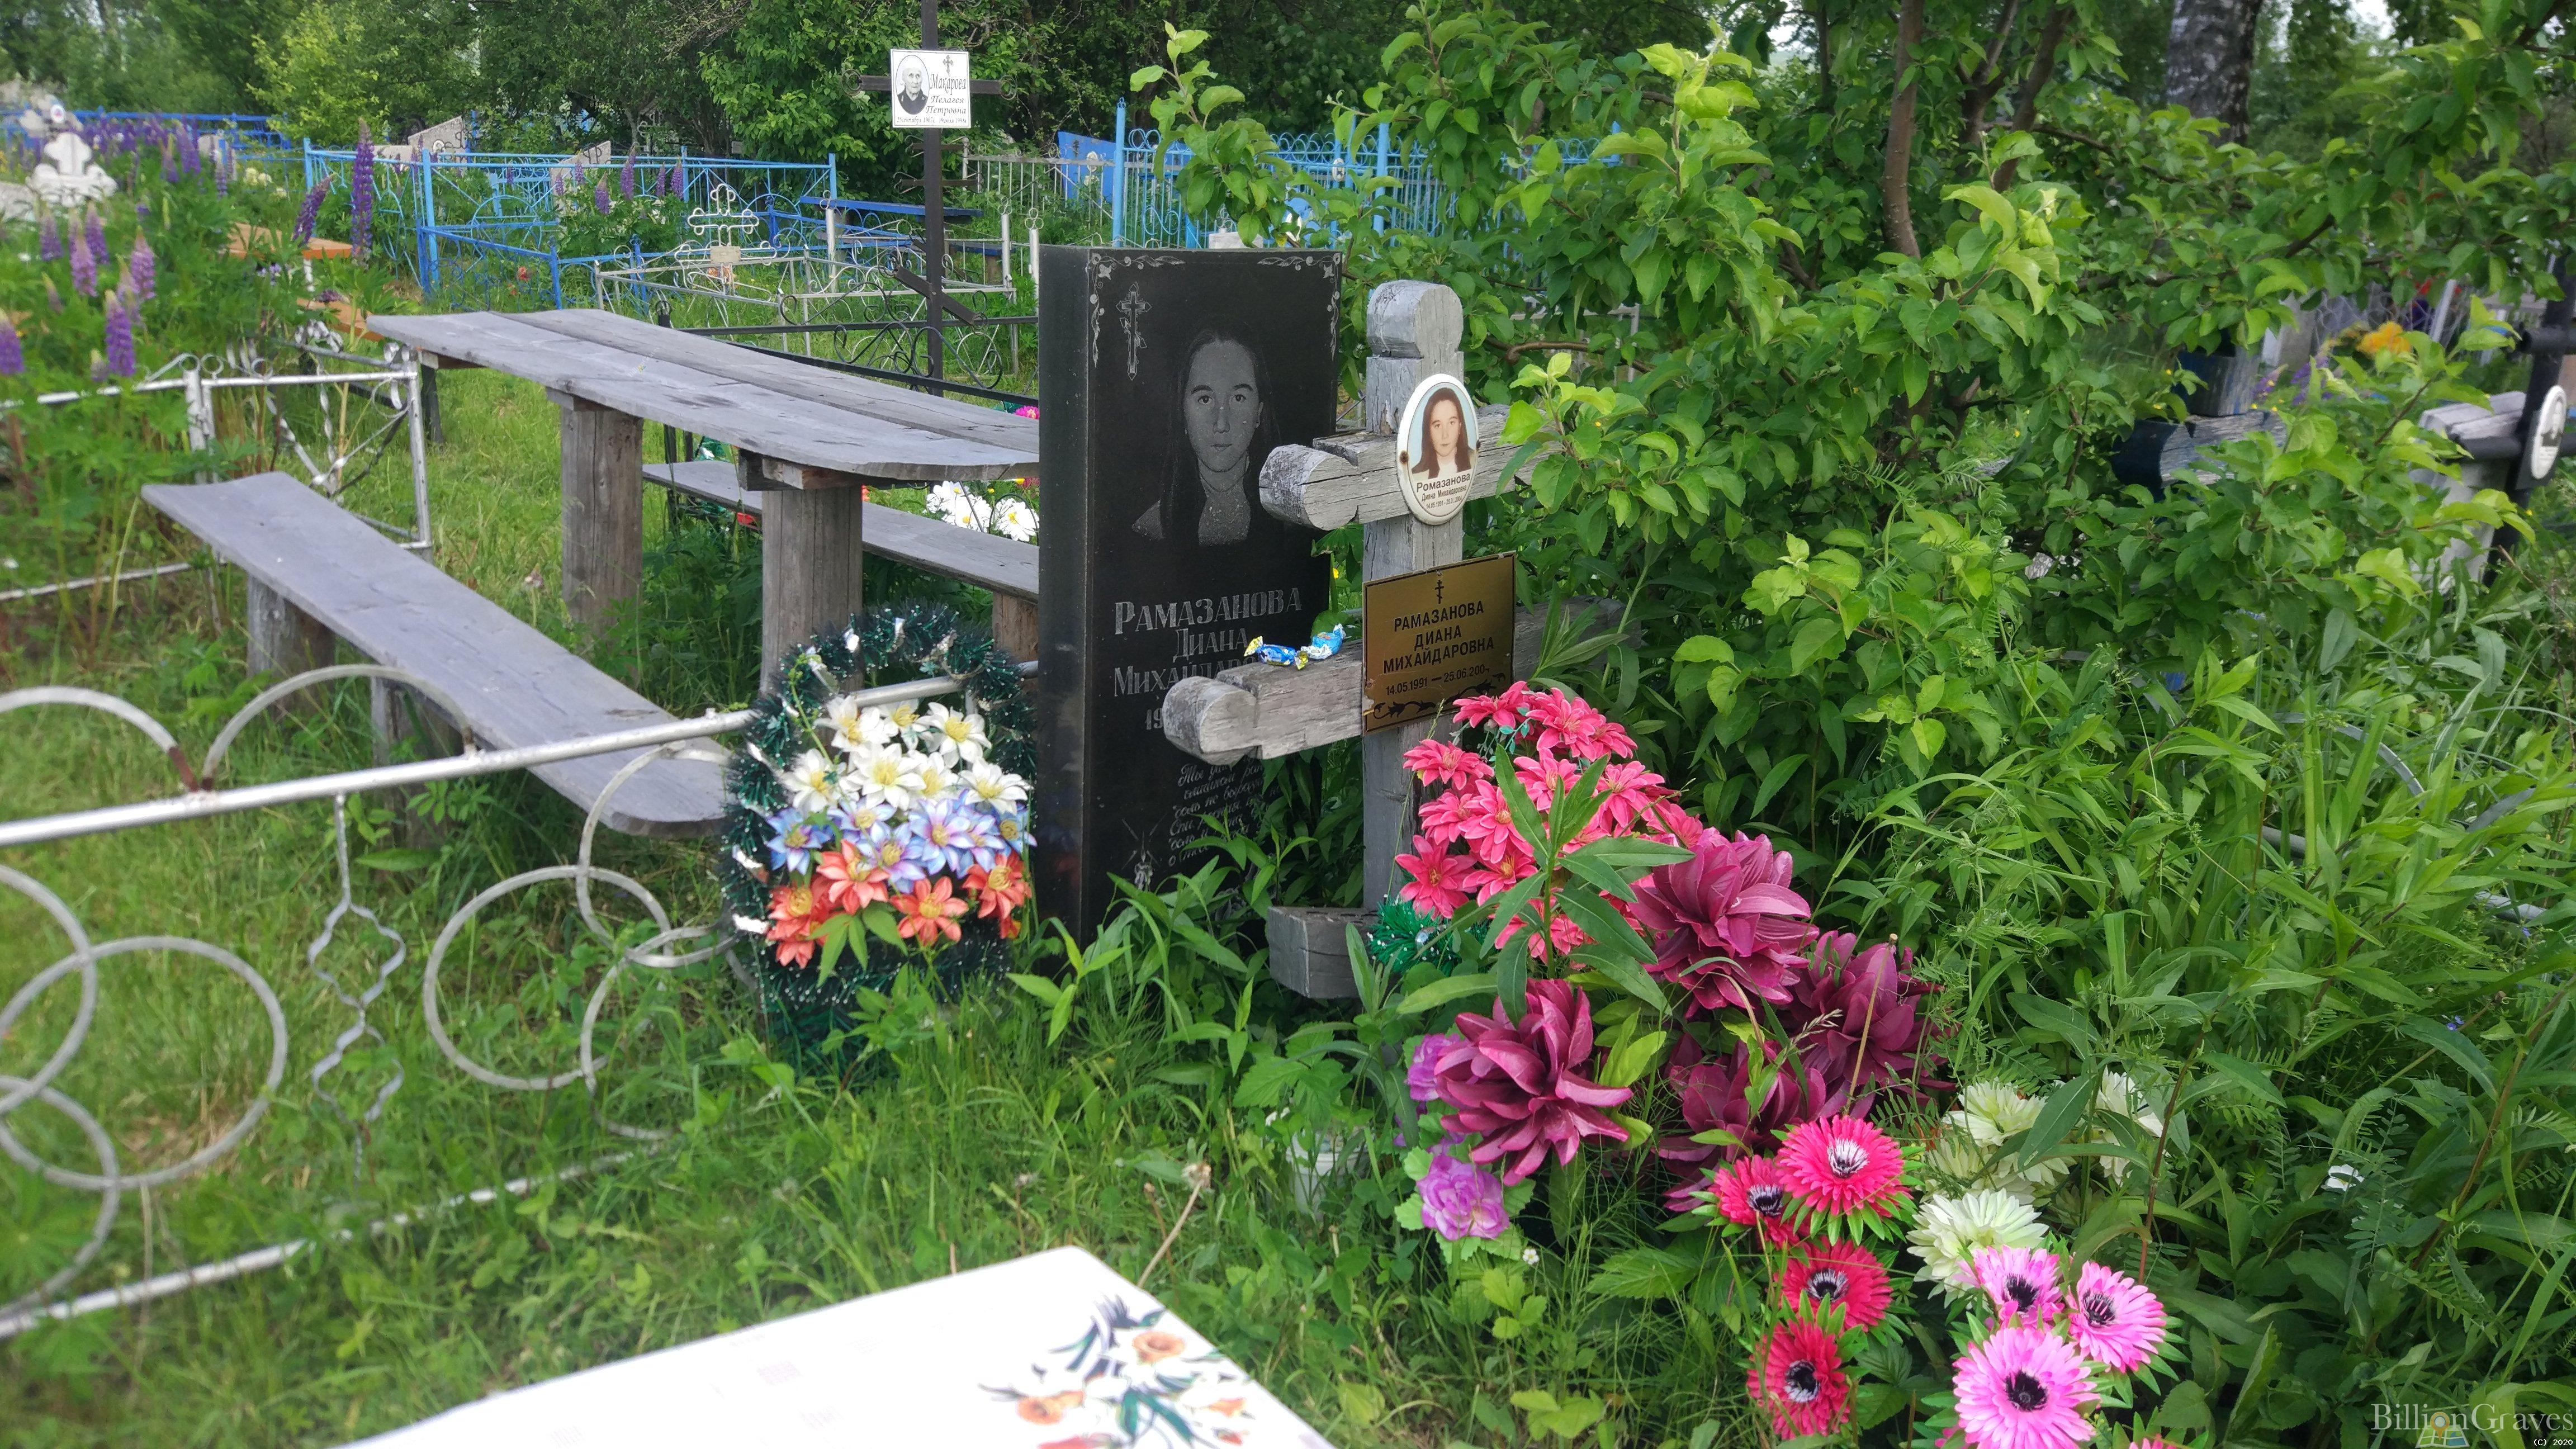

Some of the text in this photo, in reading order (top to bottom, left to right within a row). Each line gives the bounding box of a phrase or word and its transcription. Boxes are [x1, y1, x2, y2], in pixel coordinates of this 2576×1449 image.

[925, 106, 966, 116] Петровна
[1417, 473, 1470, 492] Ромазанова
[1422, 493, 1436, 503] Диана
[1394, 600, 1484, 632] РАМАЗАНОВА
[1414, 625, 1462, 651] ДИАНА
[1384, 636, 1494, 674] МИХАЙДАРОВНА
[1386, 677, 1427, 695] 14.05.1991
